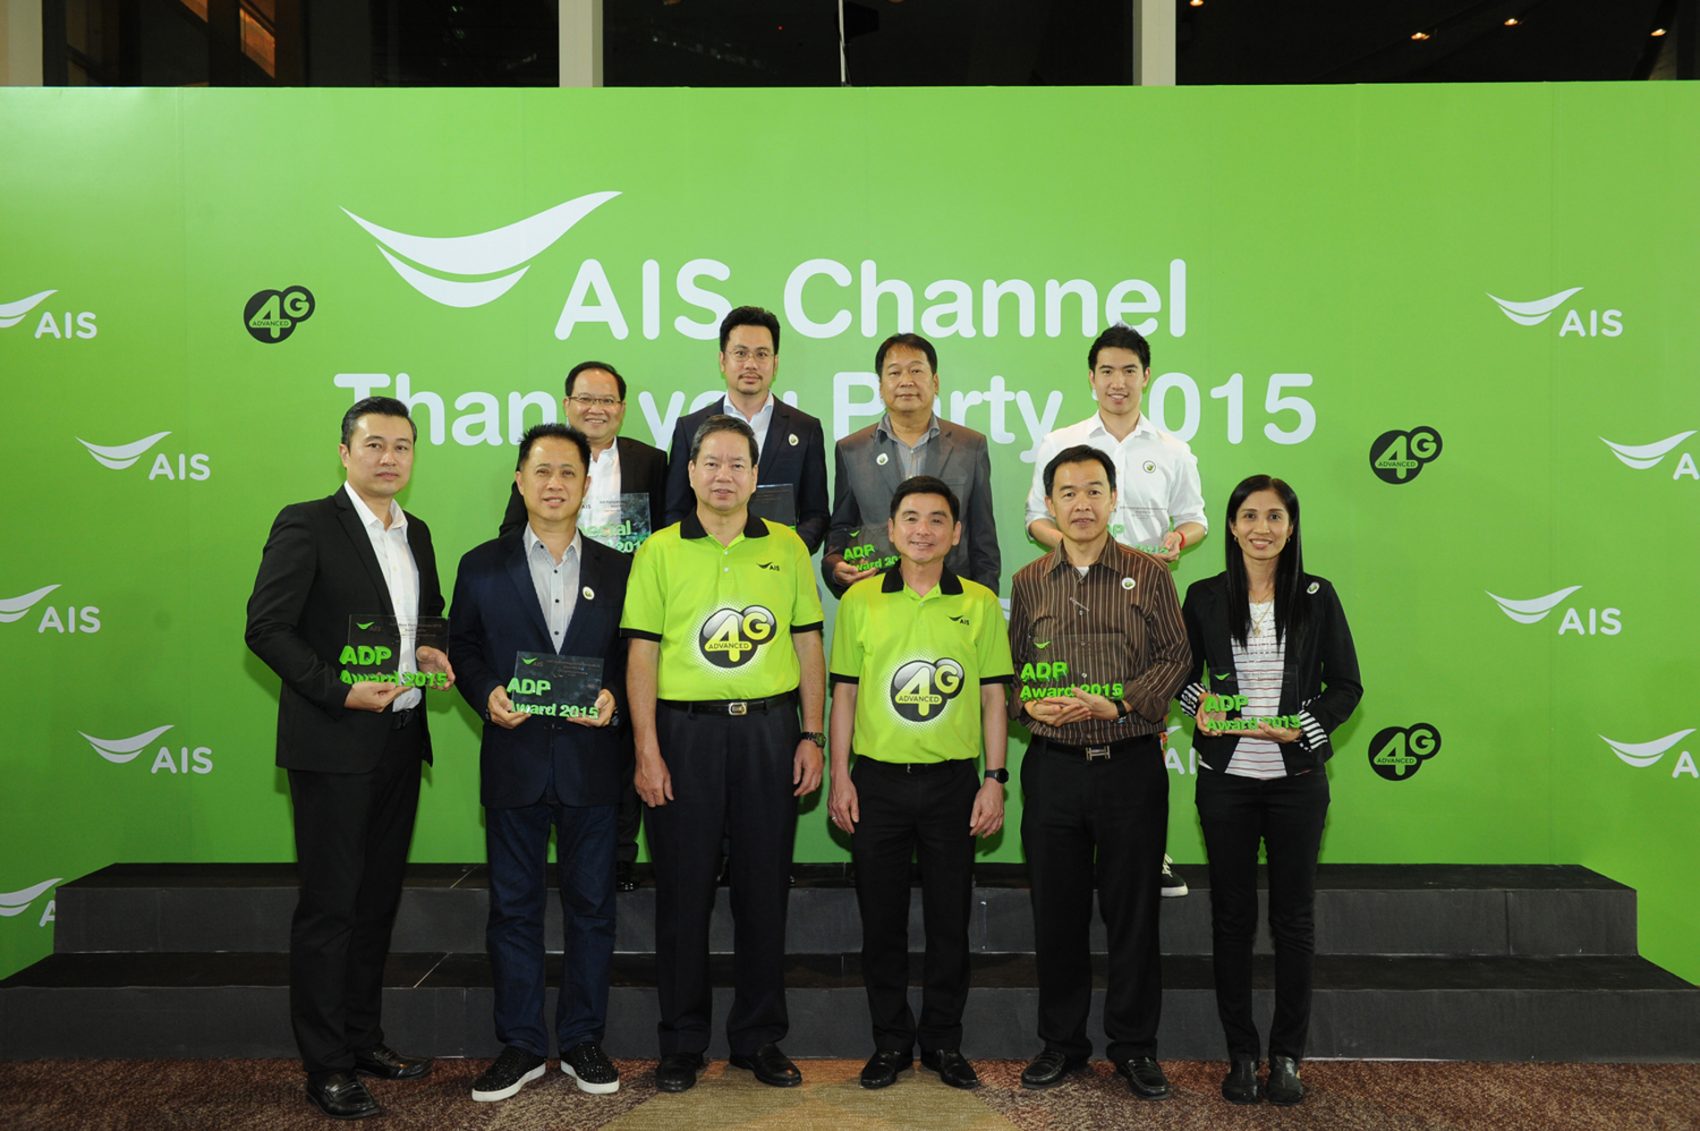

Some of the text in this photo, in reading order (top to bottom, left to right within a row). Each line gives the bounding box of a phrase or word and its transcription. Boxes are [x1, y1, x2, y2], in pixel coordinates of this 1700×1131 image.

[554, 257, 1187, 341] AIS Channel
[34, 311, 97, 339] AIS
[1559, 309, 1624, 337] AIS
[333, 372, 559, 447] Than
[832, 371, 1064, 464] Prty
[1092, 371, 1317, 446] 015
[148, 453, 211, 481] AIS
[1378, 460, 1417, 468] ADVANCED
[37, 606, 101, 634] AIS
[1558, 607, 1622, 636] AIS
[340, 645, 393, 667] ADP
[1020, 661, 1069, 683] ADP
[506, 677, 552, 697] ADP
[1020, 683, 1077, 702] Award
[559, 704, 600, 720] 2015
[1204, 693, 1249, 713] ADP
[150, 746, 213, 774] AIS
[1165, 747, 1197, 775] AI
